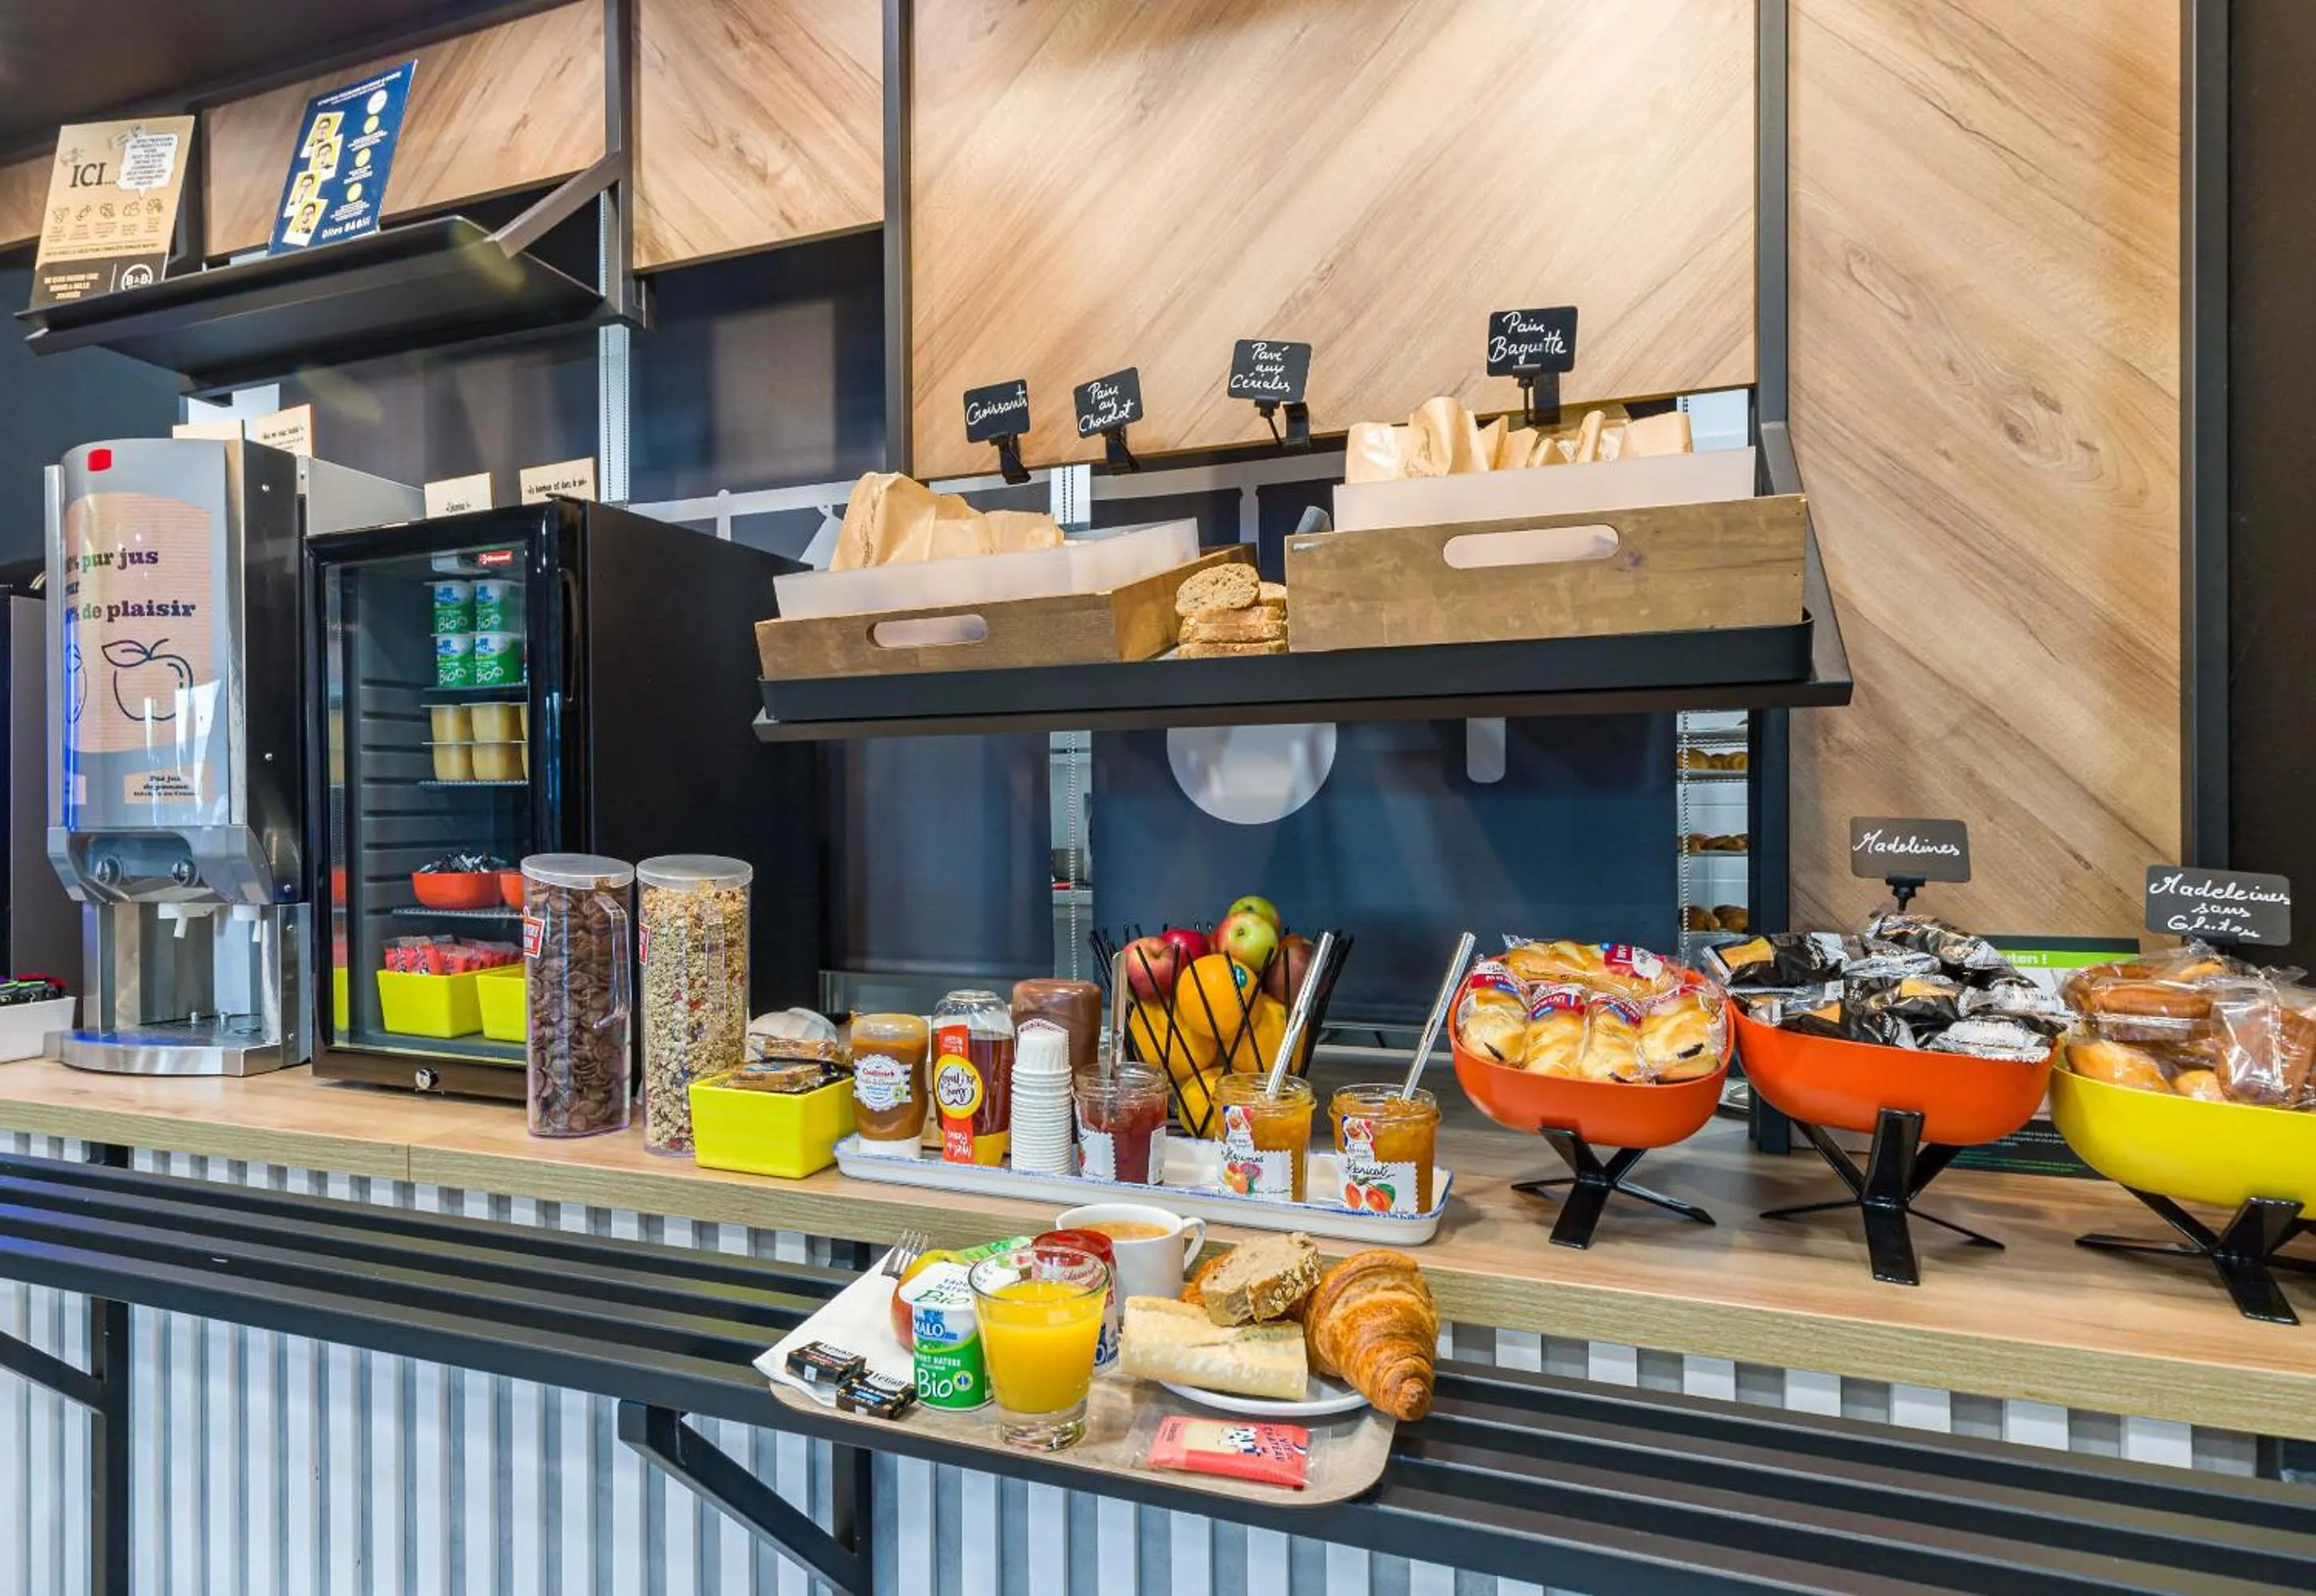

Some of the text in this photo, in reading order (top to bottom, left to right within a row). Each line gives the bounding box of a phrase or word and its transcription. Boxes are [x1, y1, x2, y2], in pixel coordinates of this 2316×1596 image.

[1502, 311, 1545, 334] Pain
[1251, 342, 1290, 361] Pavé
[1488, 328, 1567, 365] Baguette
[1087, 382, 1119, 405] Pain
[1230, 371, 1291, 392] Céréales
[966, 384, 1028, 425] Croissants
[1079, 398, 1135, 433] Chocolat
[81, 552, 114, 573] pur
[117, 548, 159, 570] jus
[82, 604, 102, 620] de
[106, 600, 196, 623] plaisir
[1852, 829, 1961, 856] Madeleines
[2149, 873, 2290, 905] Madeleines
[2191, 902, 2251, 917] sans
[917, 1367, 954, 1398] Bio
